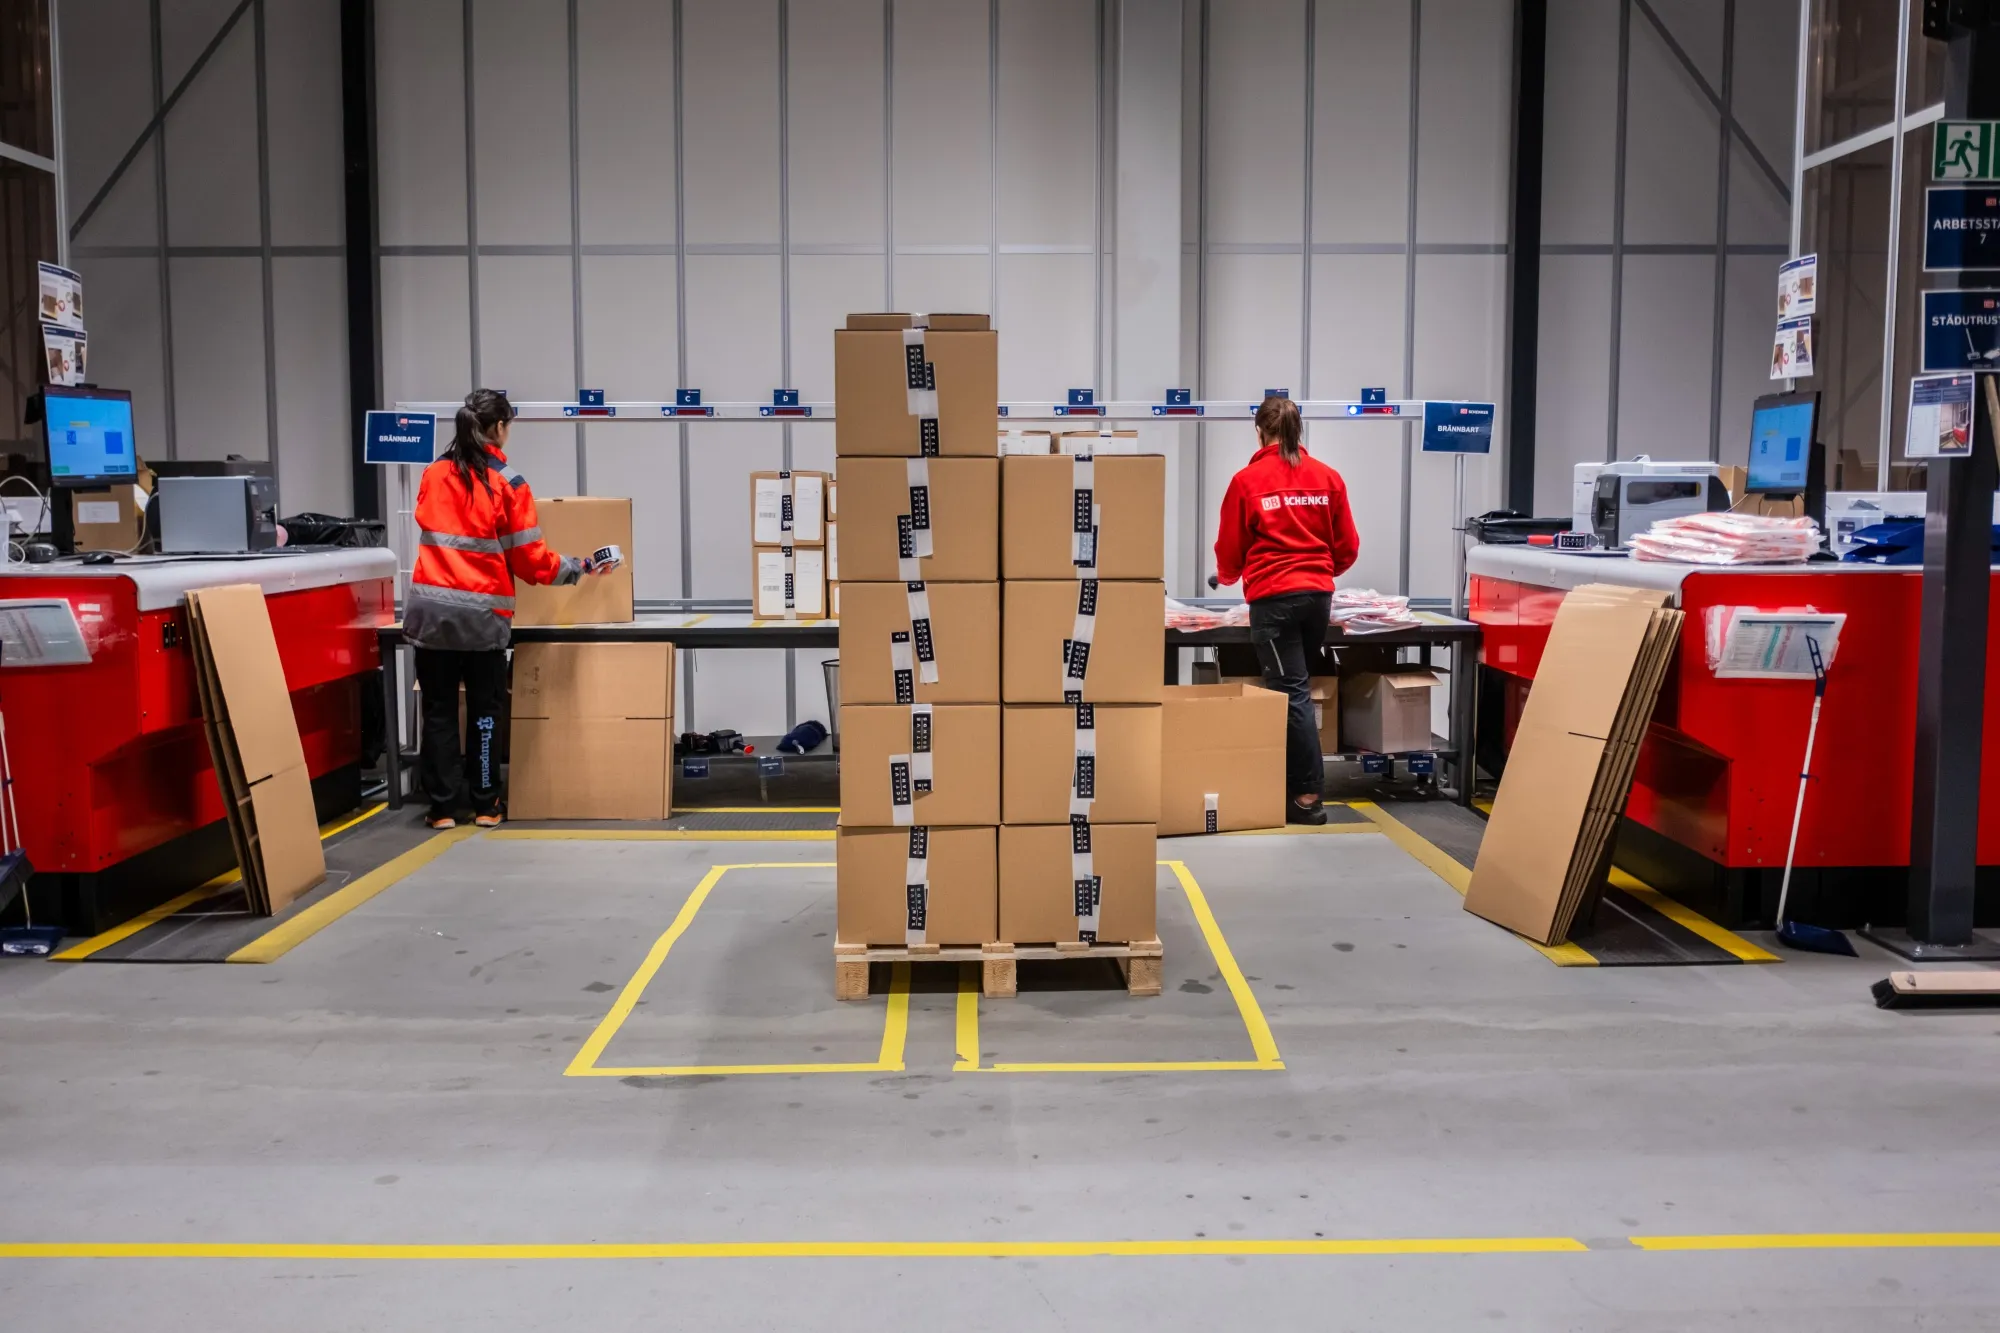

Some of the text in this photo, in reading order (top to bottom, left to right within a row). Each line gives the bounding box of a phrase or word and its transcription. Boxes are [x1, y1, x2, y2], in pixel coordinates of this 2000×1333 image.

[1980, 233, 1987, 244] 7
[909, 347, 917, 386] BRANDS
[1174, 394, 1181, 402] C
[378, 434, 421, 443] BRÄNNBART
[1437, 424, 1480, 433] BRÄNNBART
[919, 488, 927, 526] BRANDS
[1262, 495, 1330, 511] DB SCHENKE
[900, 519, 908, 555] ACTIVE
[916, 622, 925, 658] ACTIVE
[921, 622, 931, 658] BRANDS
[894, 766, 902, 802] ACTIVE
